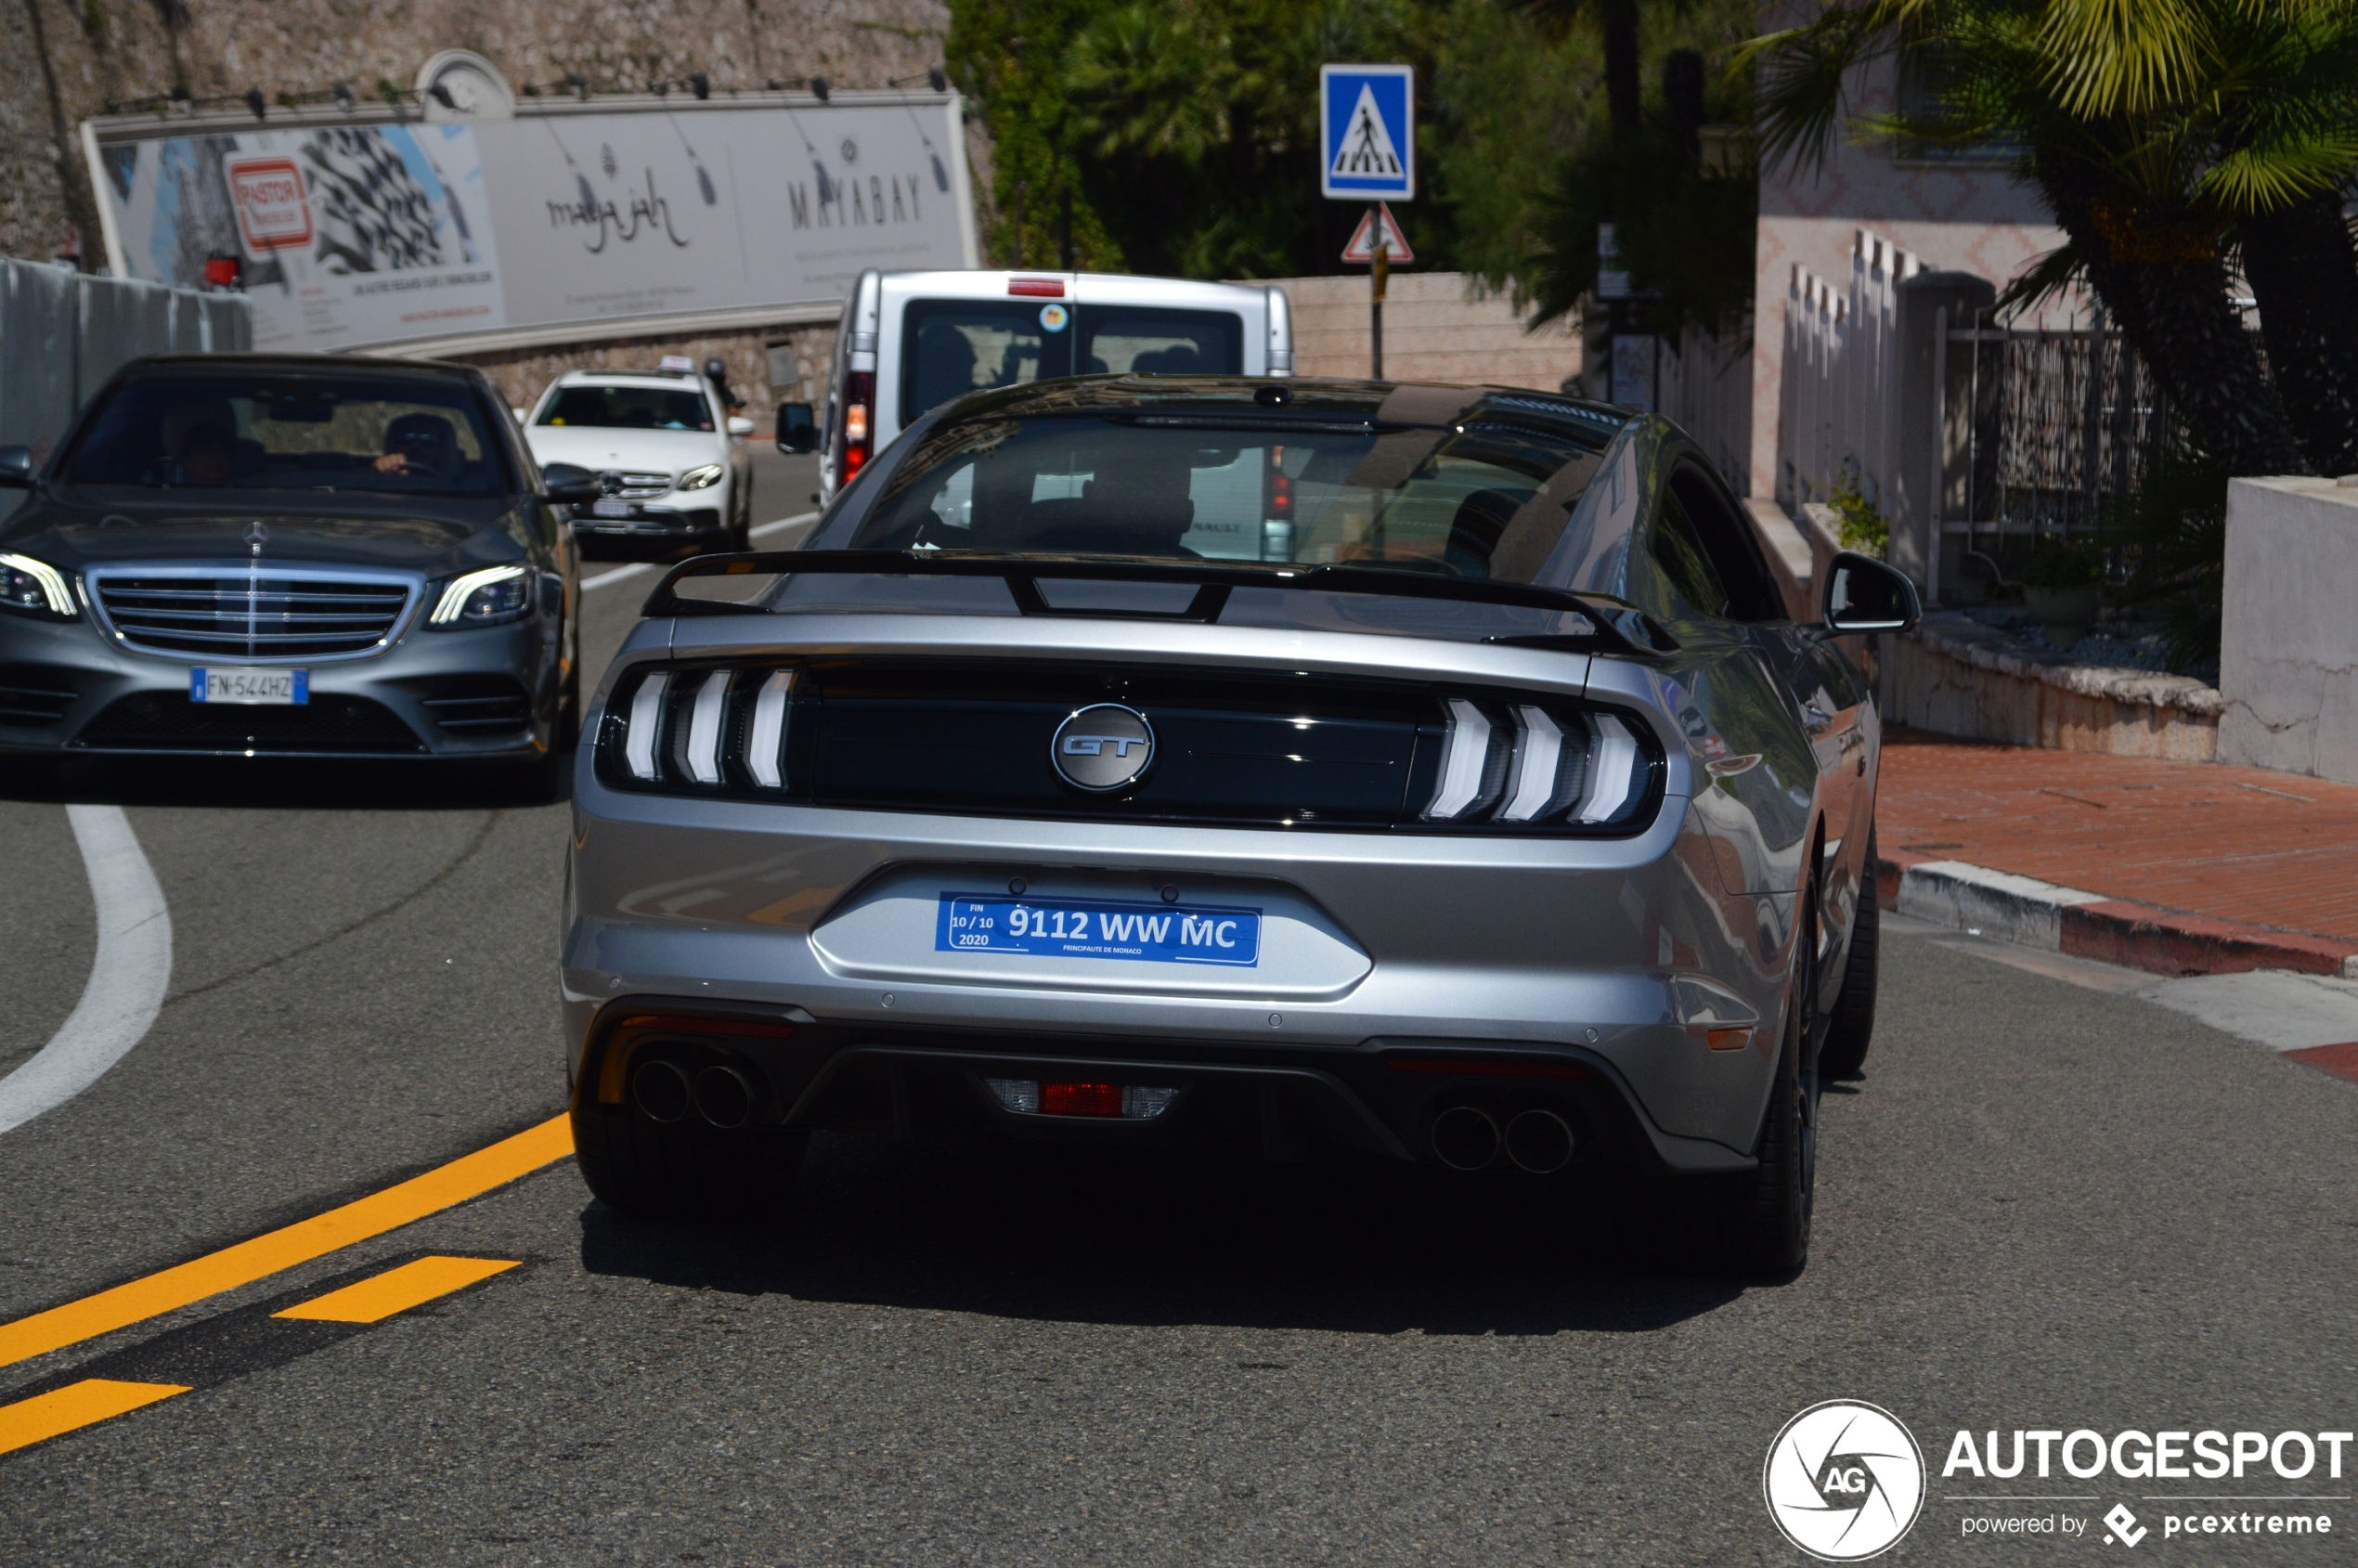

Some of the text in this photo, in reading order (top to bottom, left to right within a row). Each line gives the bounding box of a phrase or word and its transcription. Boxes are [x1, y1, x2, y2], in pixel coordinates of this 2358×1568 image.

[239, 181, 294, 204] PASTOR
[1063, 734, 1146, 758] GT
[970, 903, 984, 914] FIN
[952, 915, 966, 928] 10
[978, 917, 993, 930] 10
[1009, 909, 1237, 949] 9112 WW MC
[959, 934, 989, 947] 2020
[1063, 944, 1142, 955] PRINCIPAUTE DE MONACO
